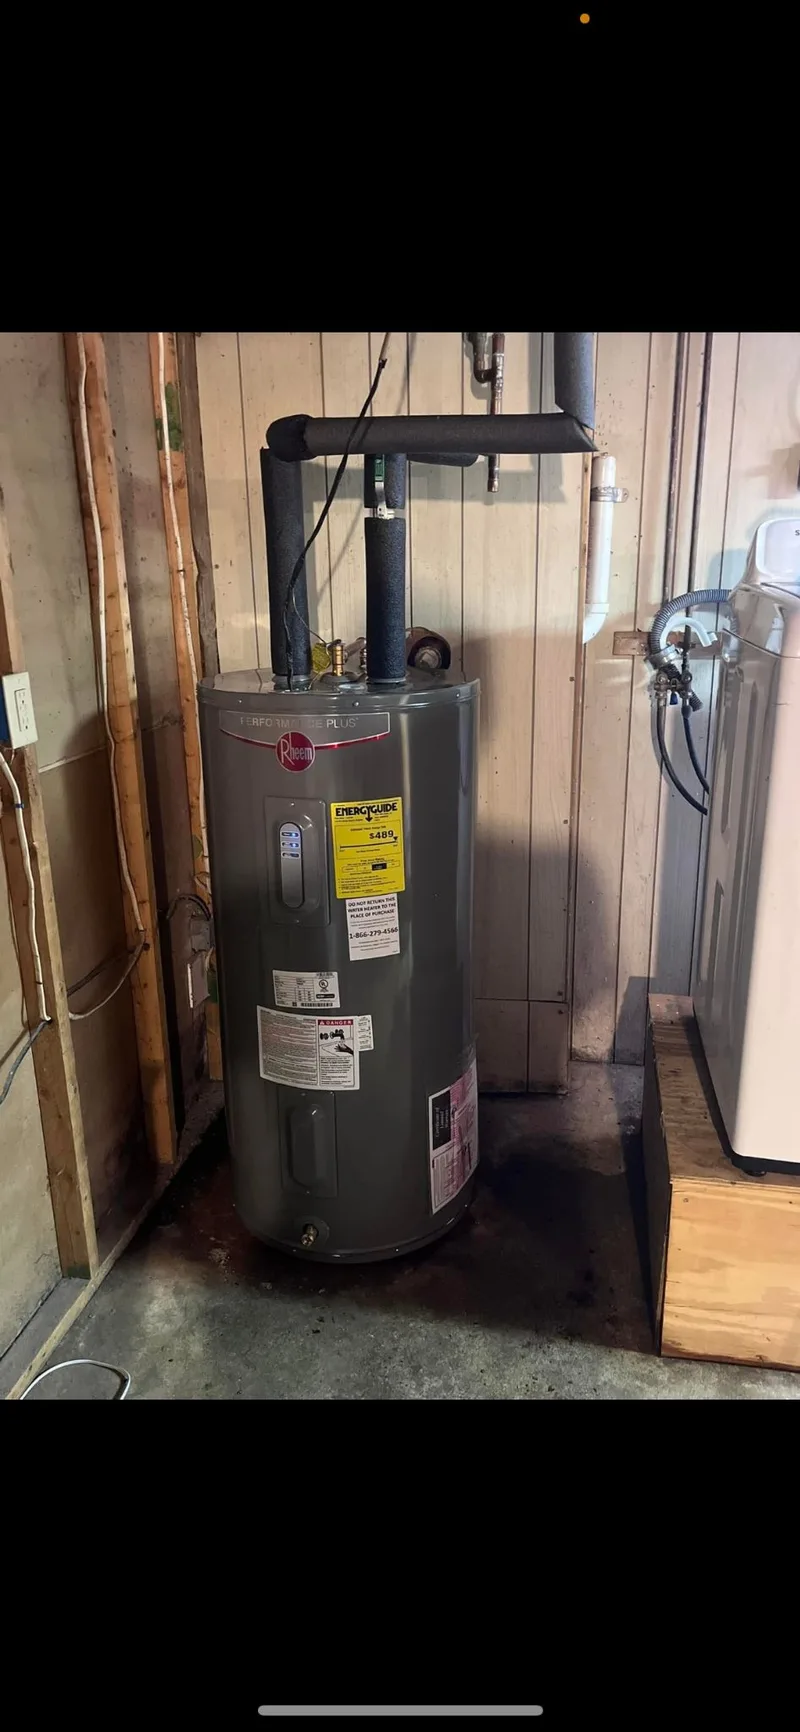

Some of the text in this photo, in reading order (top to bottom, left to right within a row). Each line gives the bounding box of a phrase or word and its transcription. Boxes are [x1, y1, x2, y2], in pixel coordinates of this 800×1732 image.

[240, 717, 357, 728] PERFORMCE PLUS
[281, 732, 313, 765] Rheem
[335, 802, 398, 817] ENERGYGUIDE
[369, 830, 394, 839] $489
[349, 926, 399, 939] 1-866-279-4566
